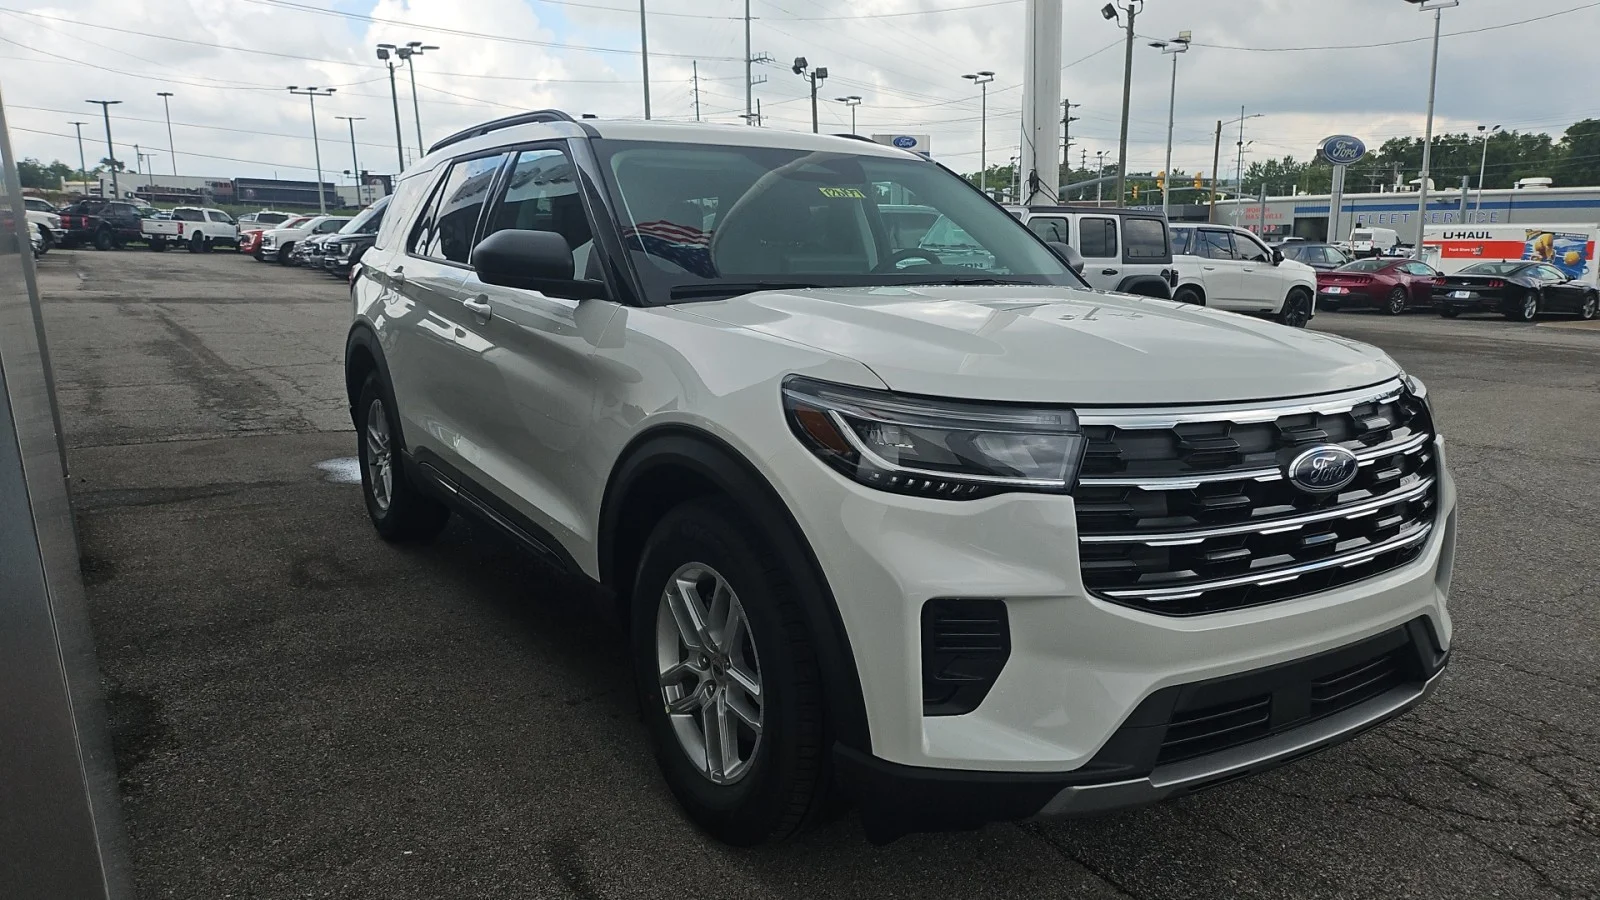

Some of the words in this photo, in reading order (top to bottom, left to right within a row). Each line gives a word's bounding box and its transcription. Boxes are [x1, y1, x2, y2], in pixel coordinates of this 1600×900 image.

[1332, 140, 1360, 158] Ford
[1358, 213, 1410, 224] FLEET
[1443, 231, 1492, 240] U-HAUL
[1310, 454, 1347, 483] Ford
